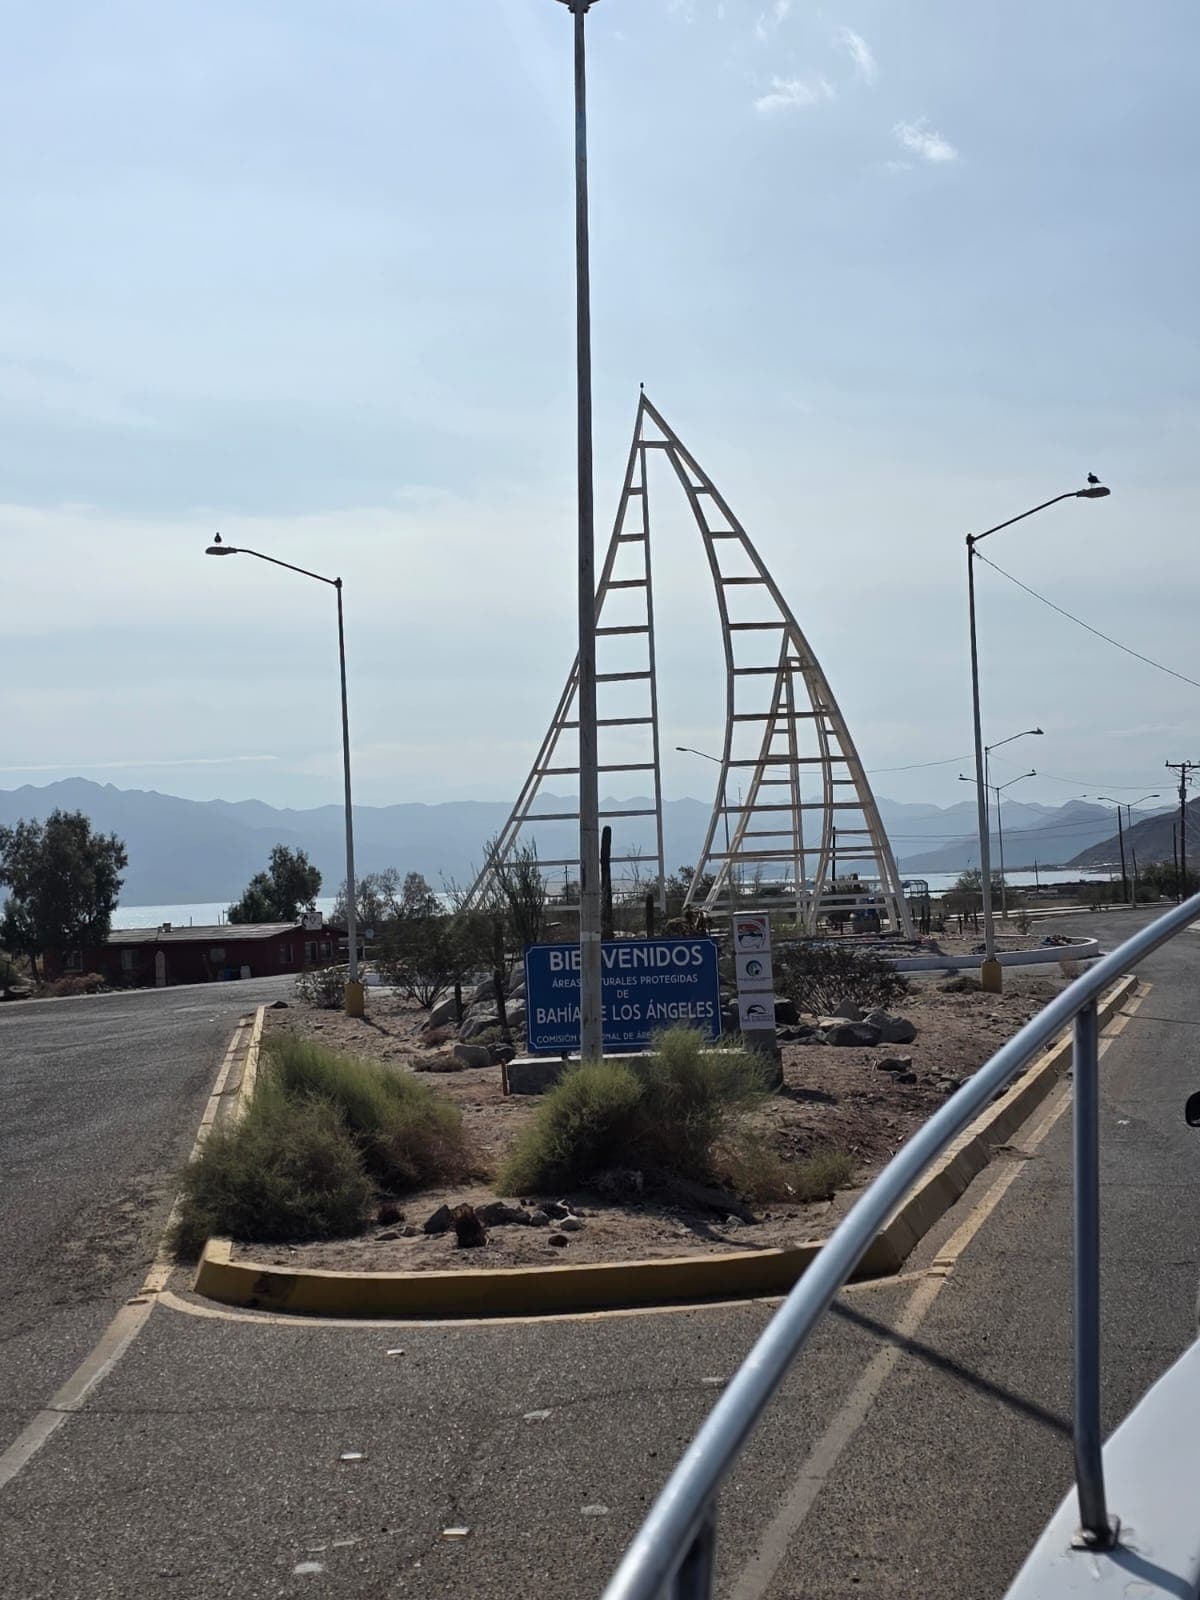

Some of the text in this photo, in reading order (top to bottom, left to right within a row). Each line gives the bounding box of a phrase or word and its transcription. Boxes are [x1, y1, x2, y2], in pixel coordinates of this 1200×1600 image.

[550, 946, 703, 971] BIEVENIDOS
[640, 973, 698, 985] PROTEGIDAS
[616, 989, 629, 999] DE
[536, 1003, 581, 1024] BAHÍA
[612, 1004, 641, 1021] LOS
[646, 999, 714, 1020] ÁNGELES
[623, 1032, 633, 1040] DE
